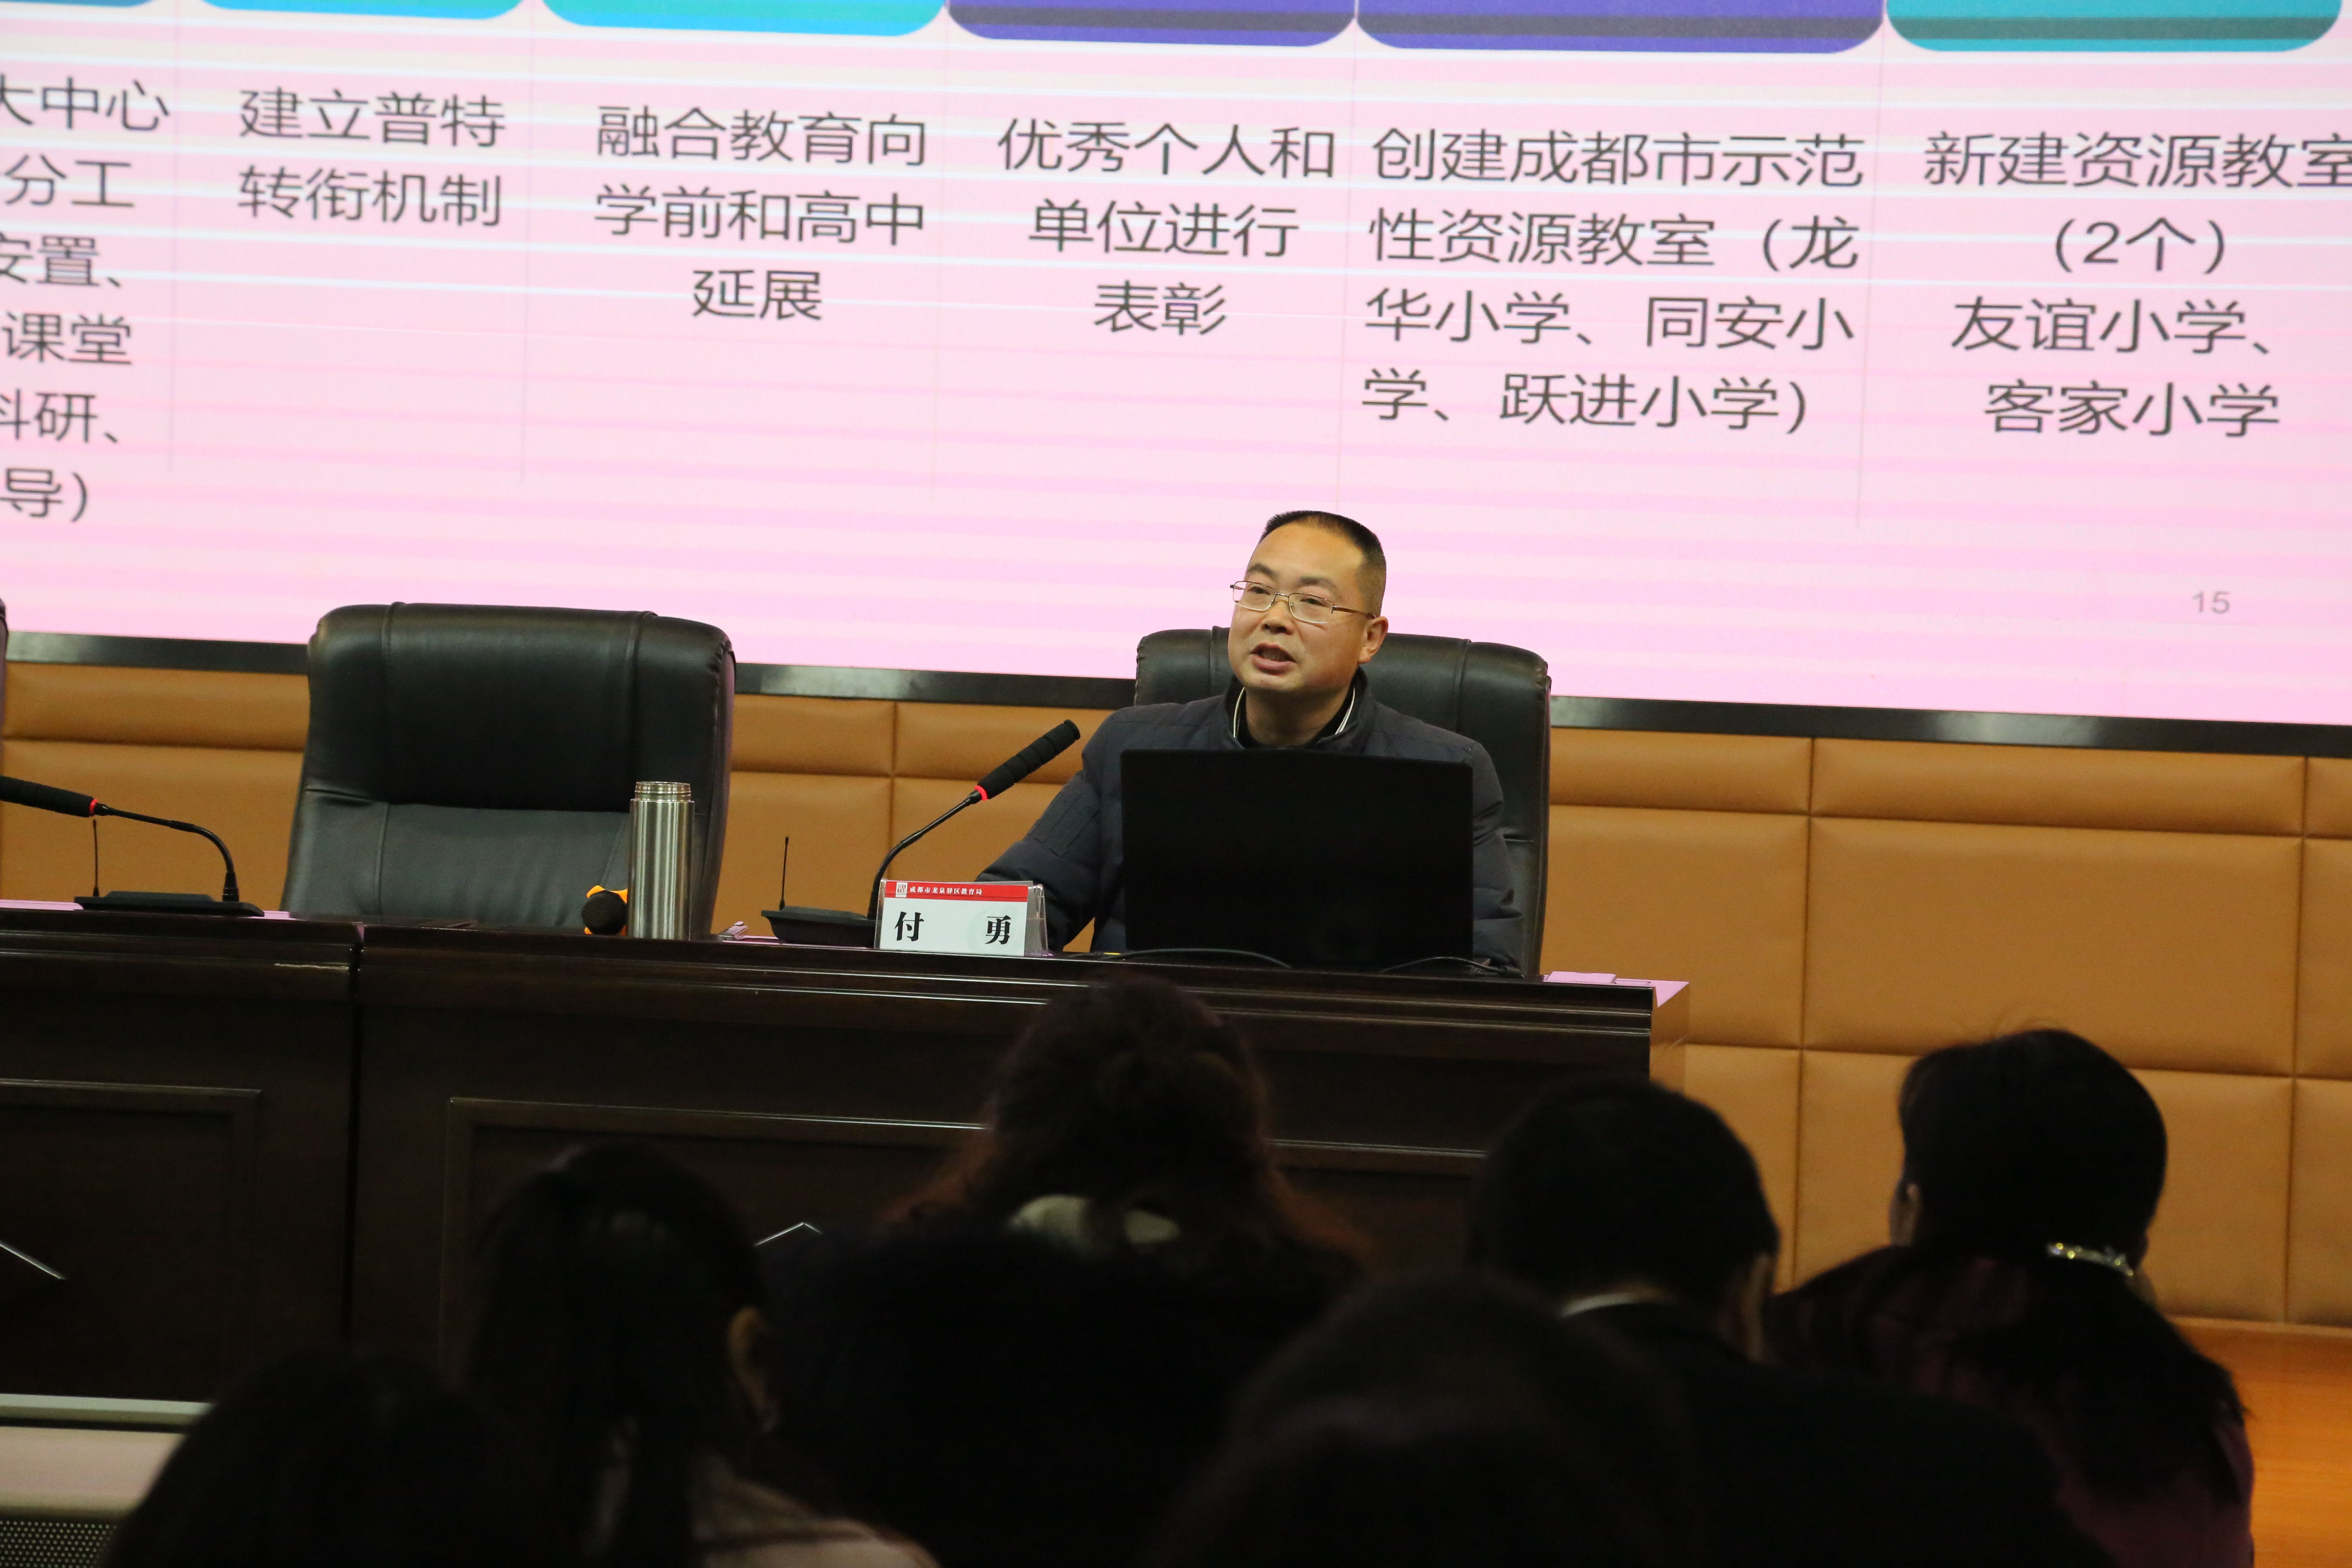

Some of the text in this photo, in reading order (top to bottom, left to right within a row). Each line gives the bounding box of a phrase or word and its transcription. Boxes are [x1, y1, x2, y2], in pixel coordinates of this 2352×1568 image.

[241, 87, 505, 147] 建立普特
[597, 106, 926, 166] 融合教育向
[998, 118, 1334, 179] 优秀个人和
[1372, 128, 1864, 187] 创建成都市示范
[1924, 131, 2352, 188] 新建资源教室
[4, 155, 133, 207] 分工
[238, 165, 501, 226] 转衔机制
[595, 184, 924, 246] 学前和高中
[1029, 198, 1299, 257] 单位进行
[693, 269, 822, 320] 延展
[1094, 280, 1227, 336] 表彰
[3, 313, 133, 365] 课堂
[1951, 296, 2269, 354] 友谊小学、
[1984, 379, 2279, 438] 客家小学
[2194, 592, 2231, 614] 15
[909, 886, 982, 895] 成都市龙泉驿区教育局
